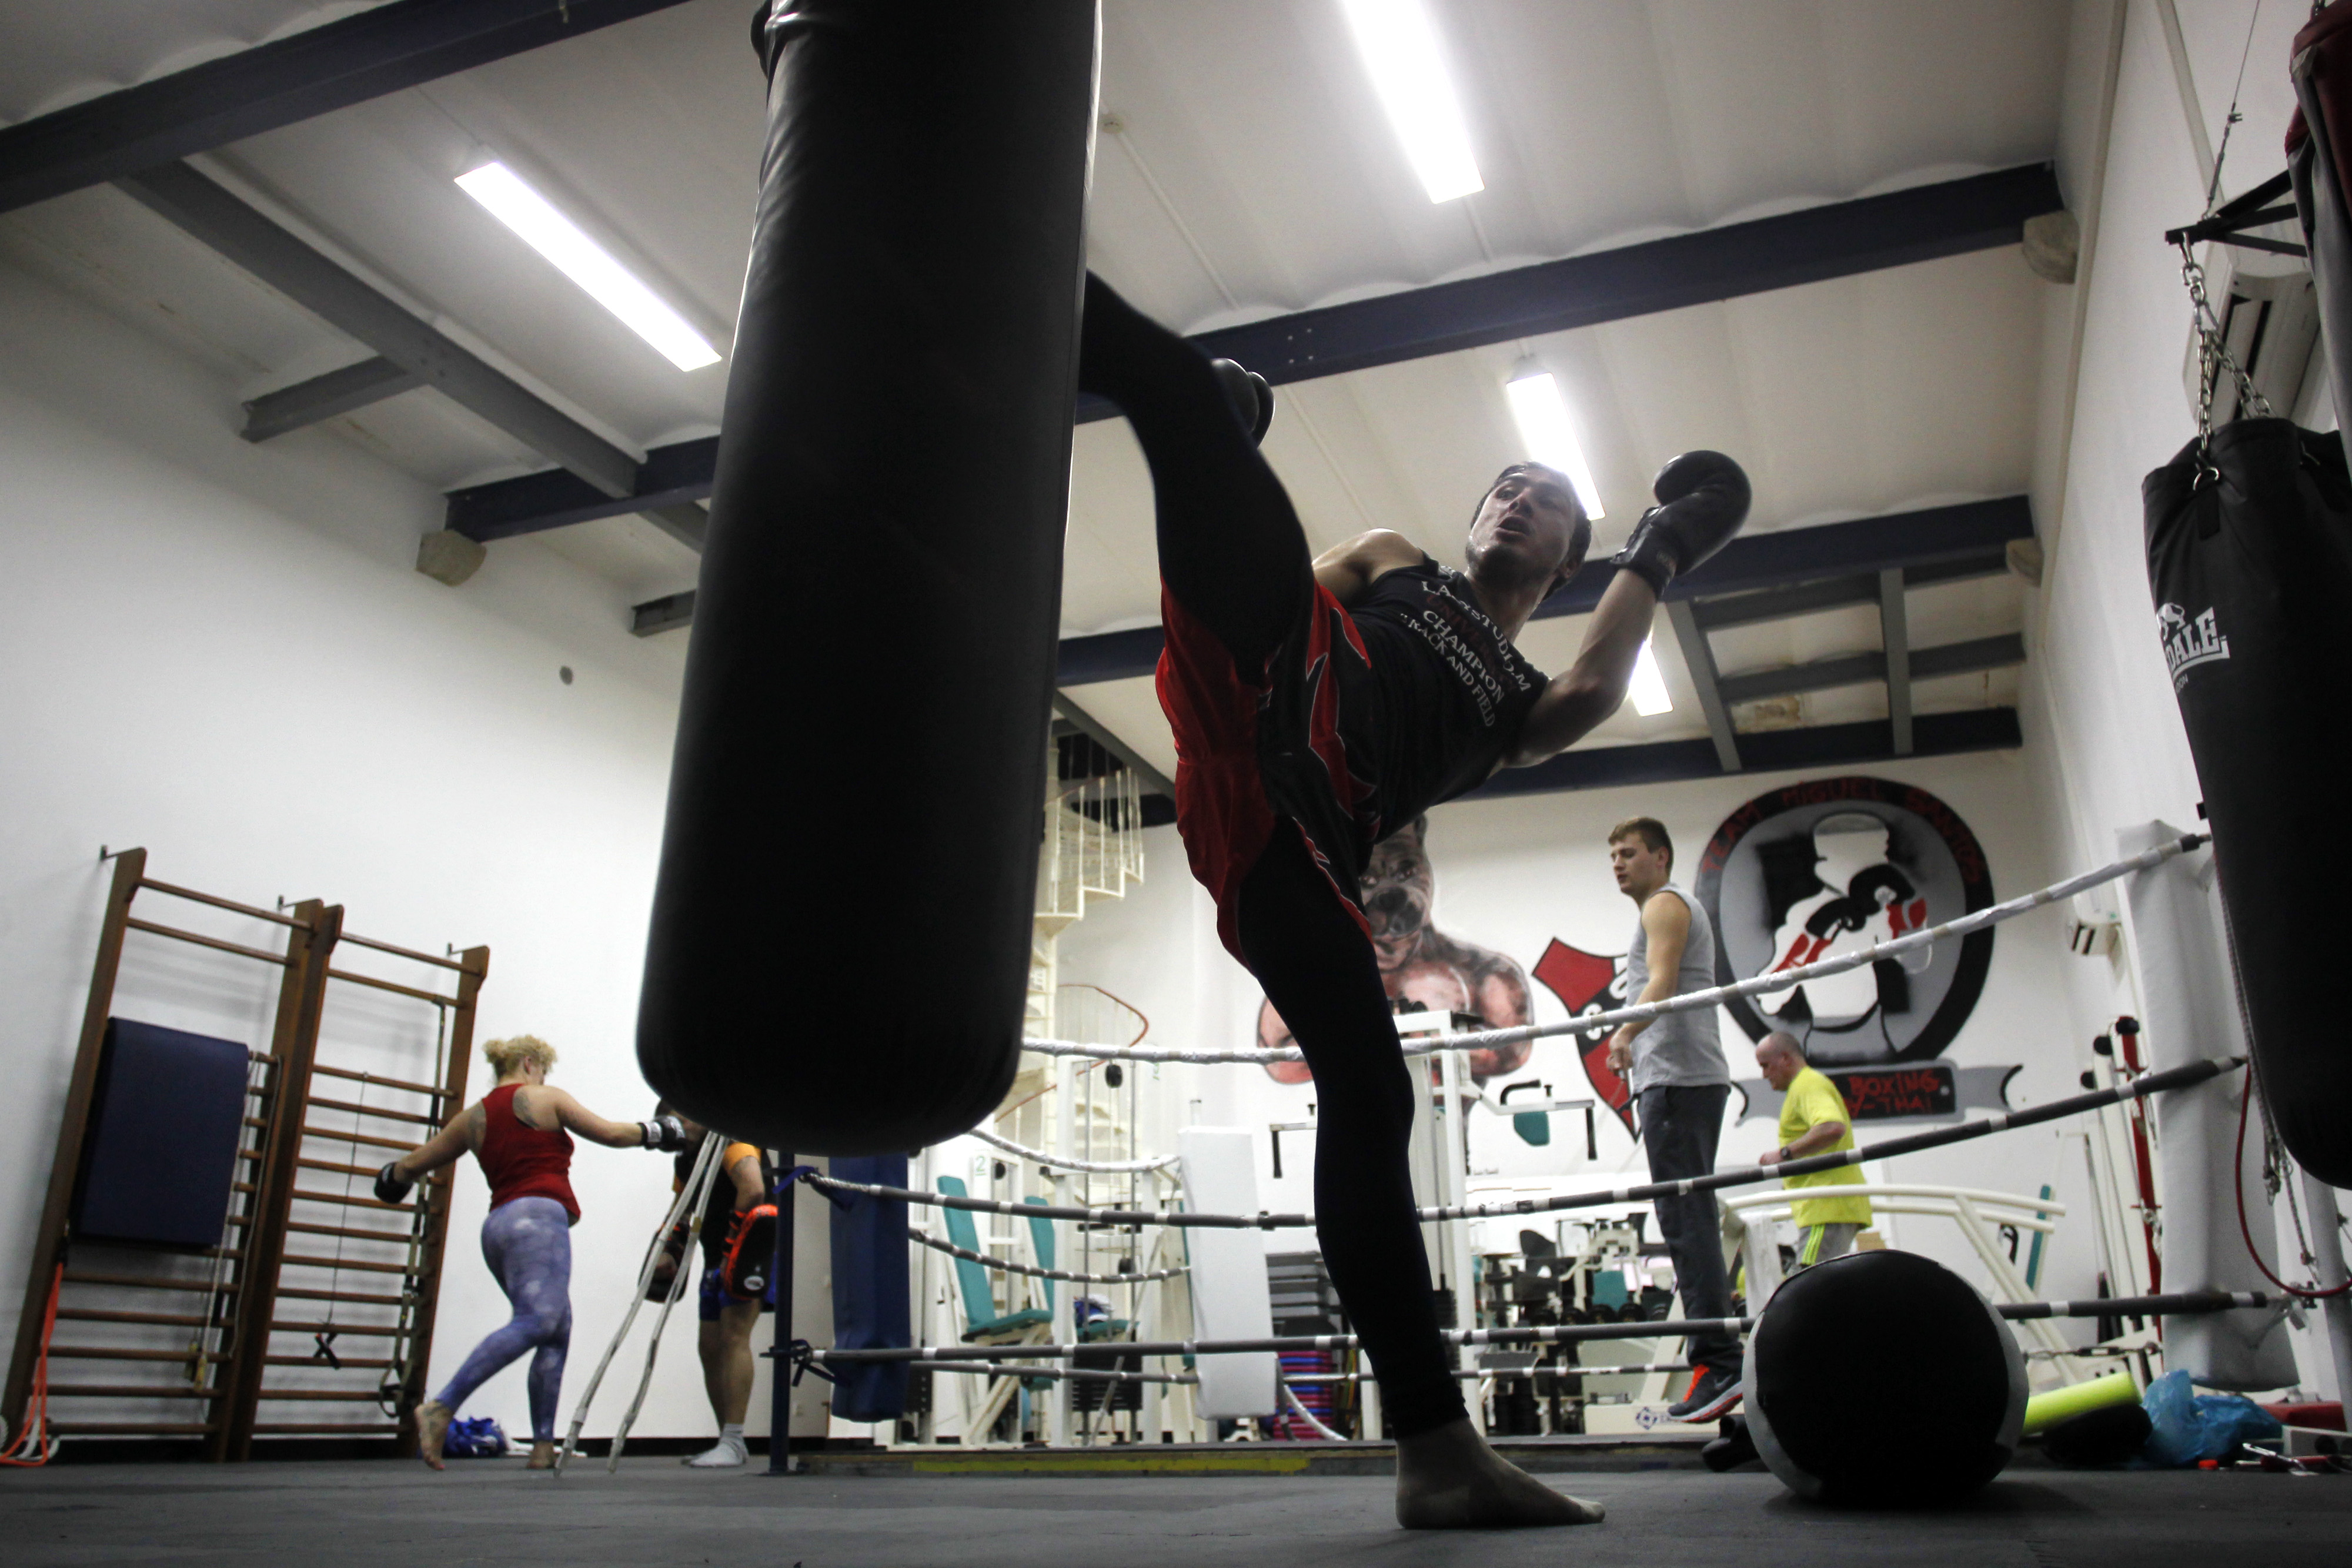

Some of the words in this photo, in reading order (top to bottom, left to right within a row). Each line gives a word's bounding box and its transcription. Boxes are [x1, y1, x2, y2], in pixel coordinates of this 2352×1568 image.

[1423, 610, 1505, 704] CHAMPION
[1446, 656, 1475, 686] AND
[1472, 684, 1495, 727] FIELD
[1848, 1069, 1940, 1096] BOXING
